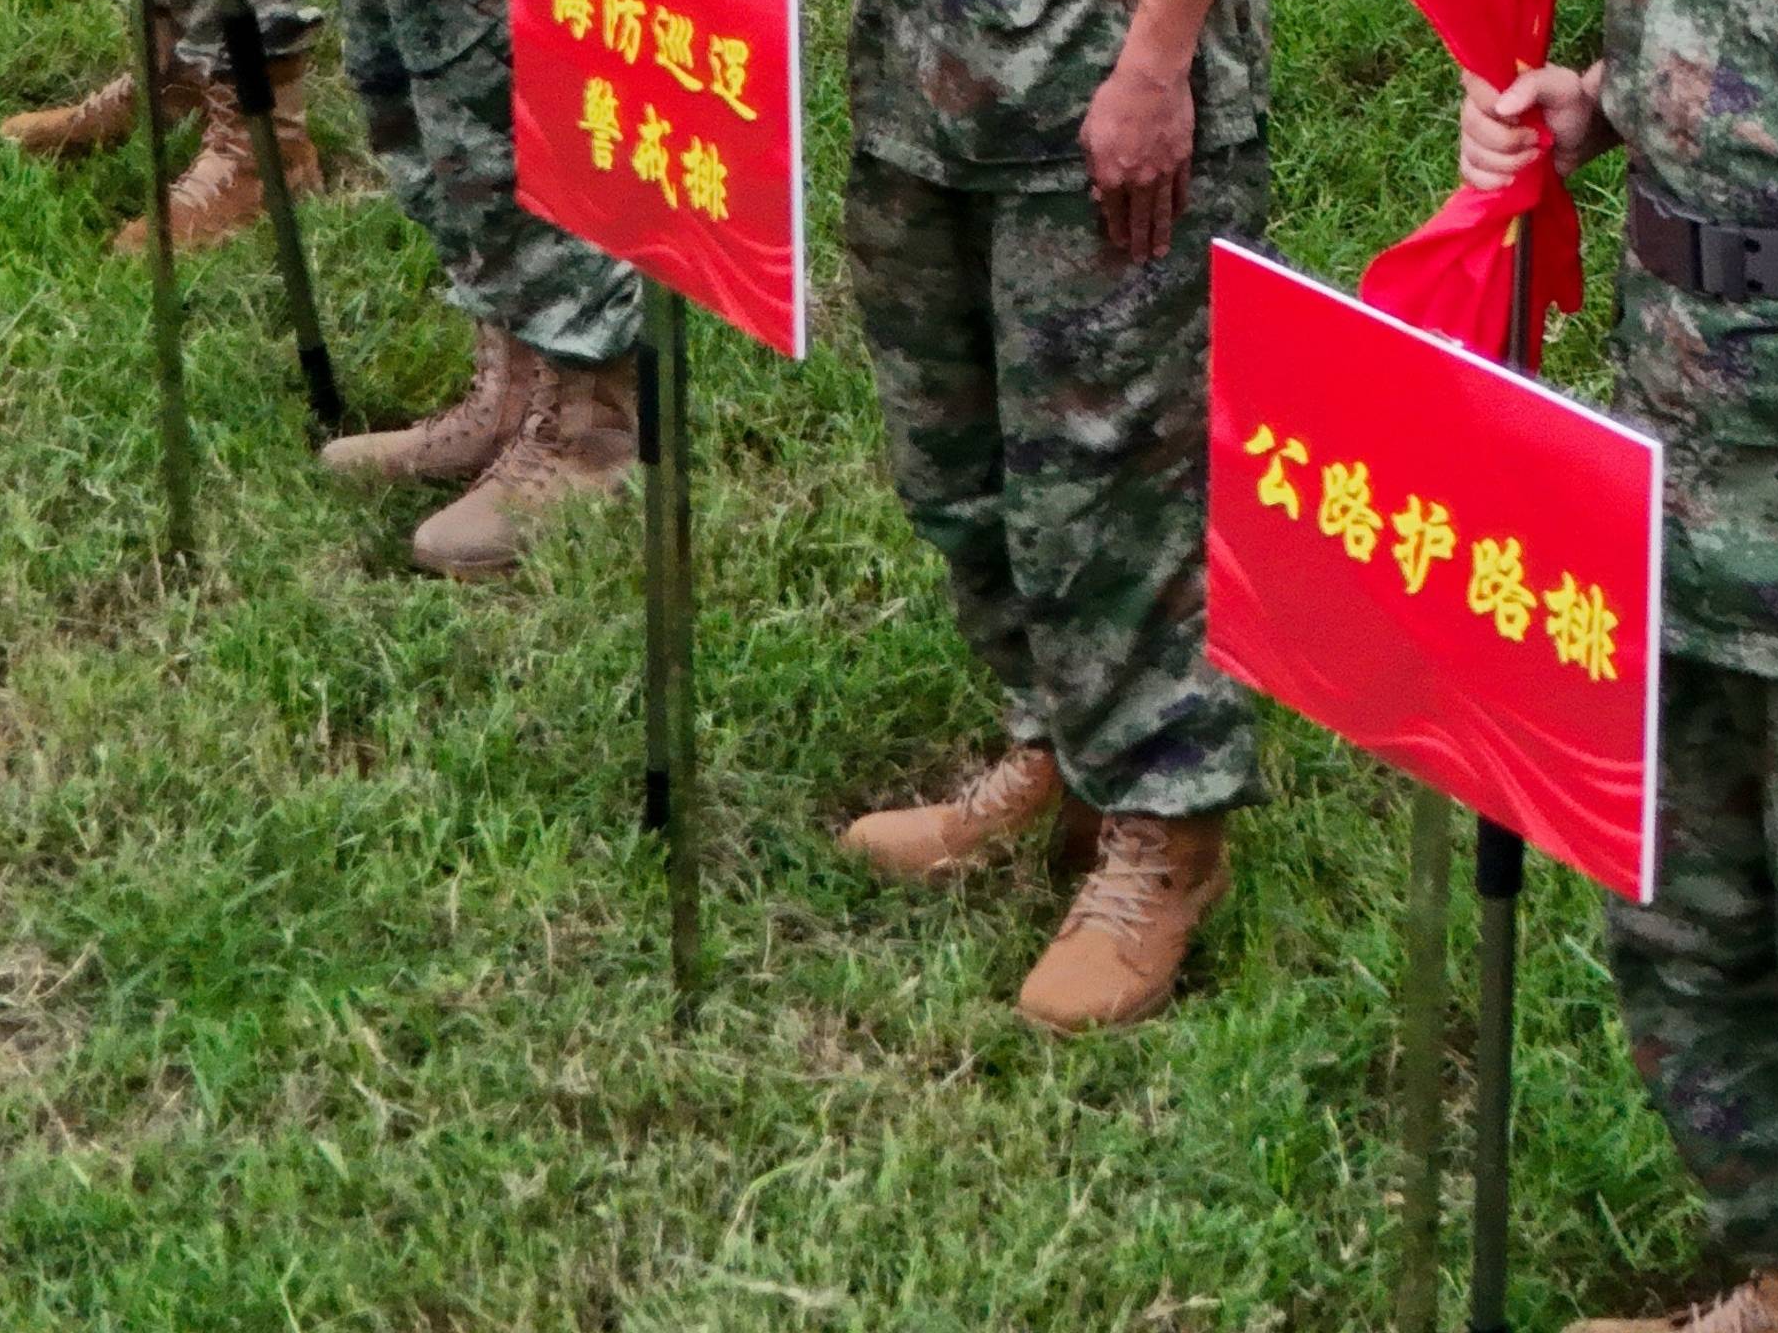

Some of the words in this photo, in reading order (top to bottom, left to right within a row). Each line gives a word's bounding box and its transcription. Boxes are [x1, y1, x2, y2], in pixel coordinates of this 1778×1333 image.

[578, 76, 730, 221] 警戒排
[1244, 424, 1618, 681] 公路护路排
